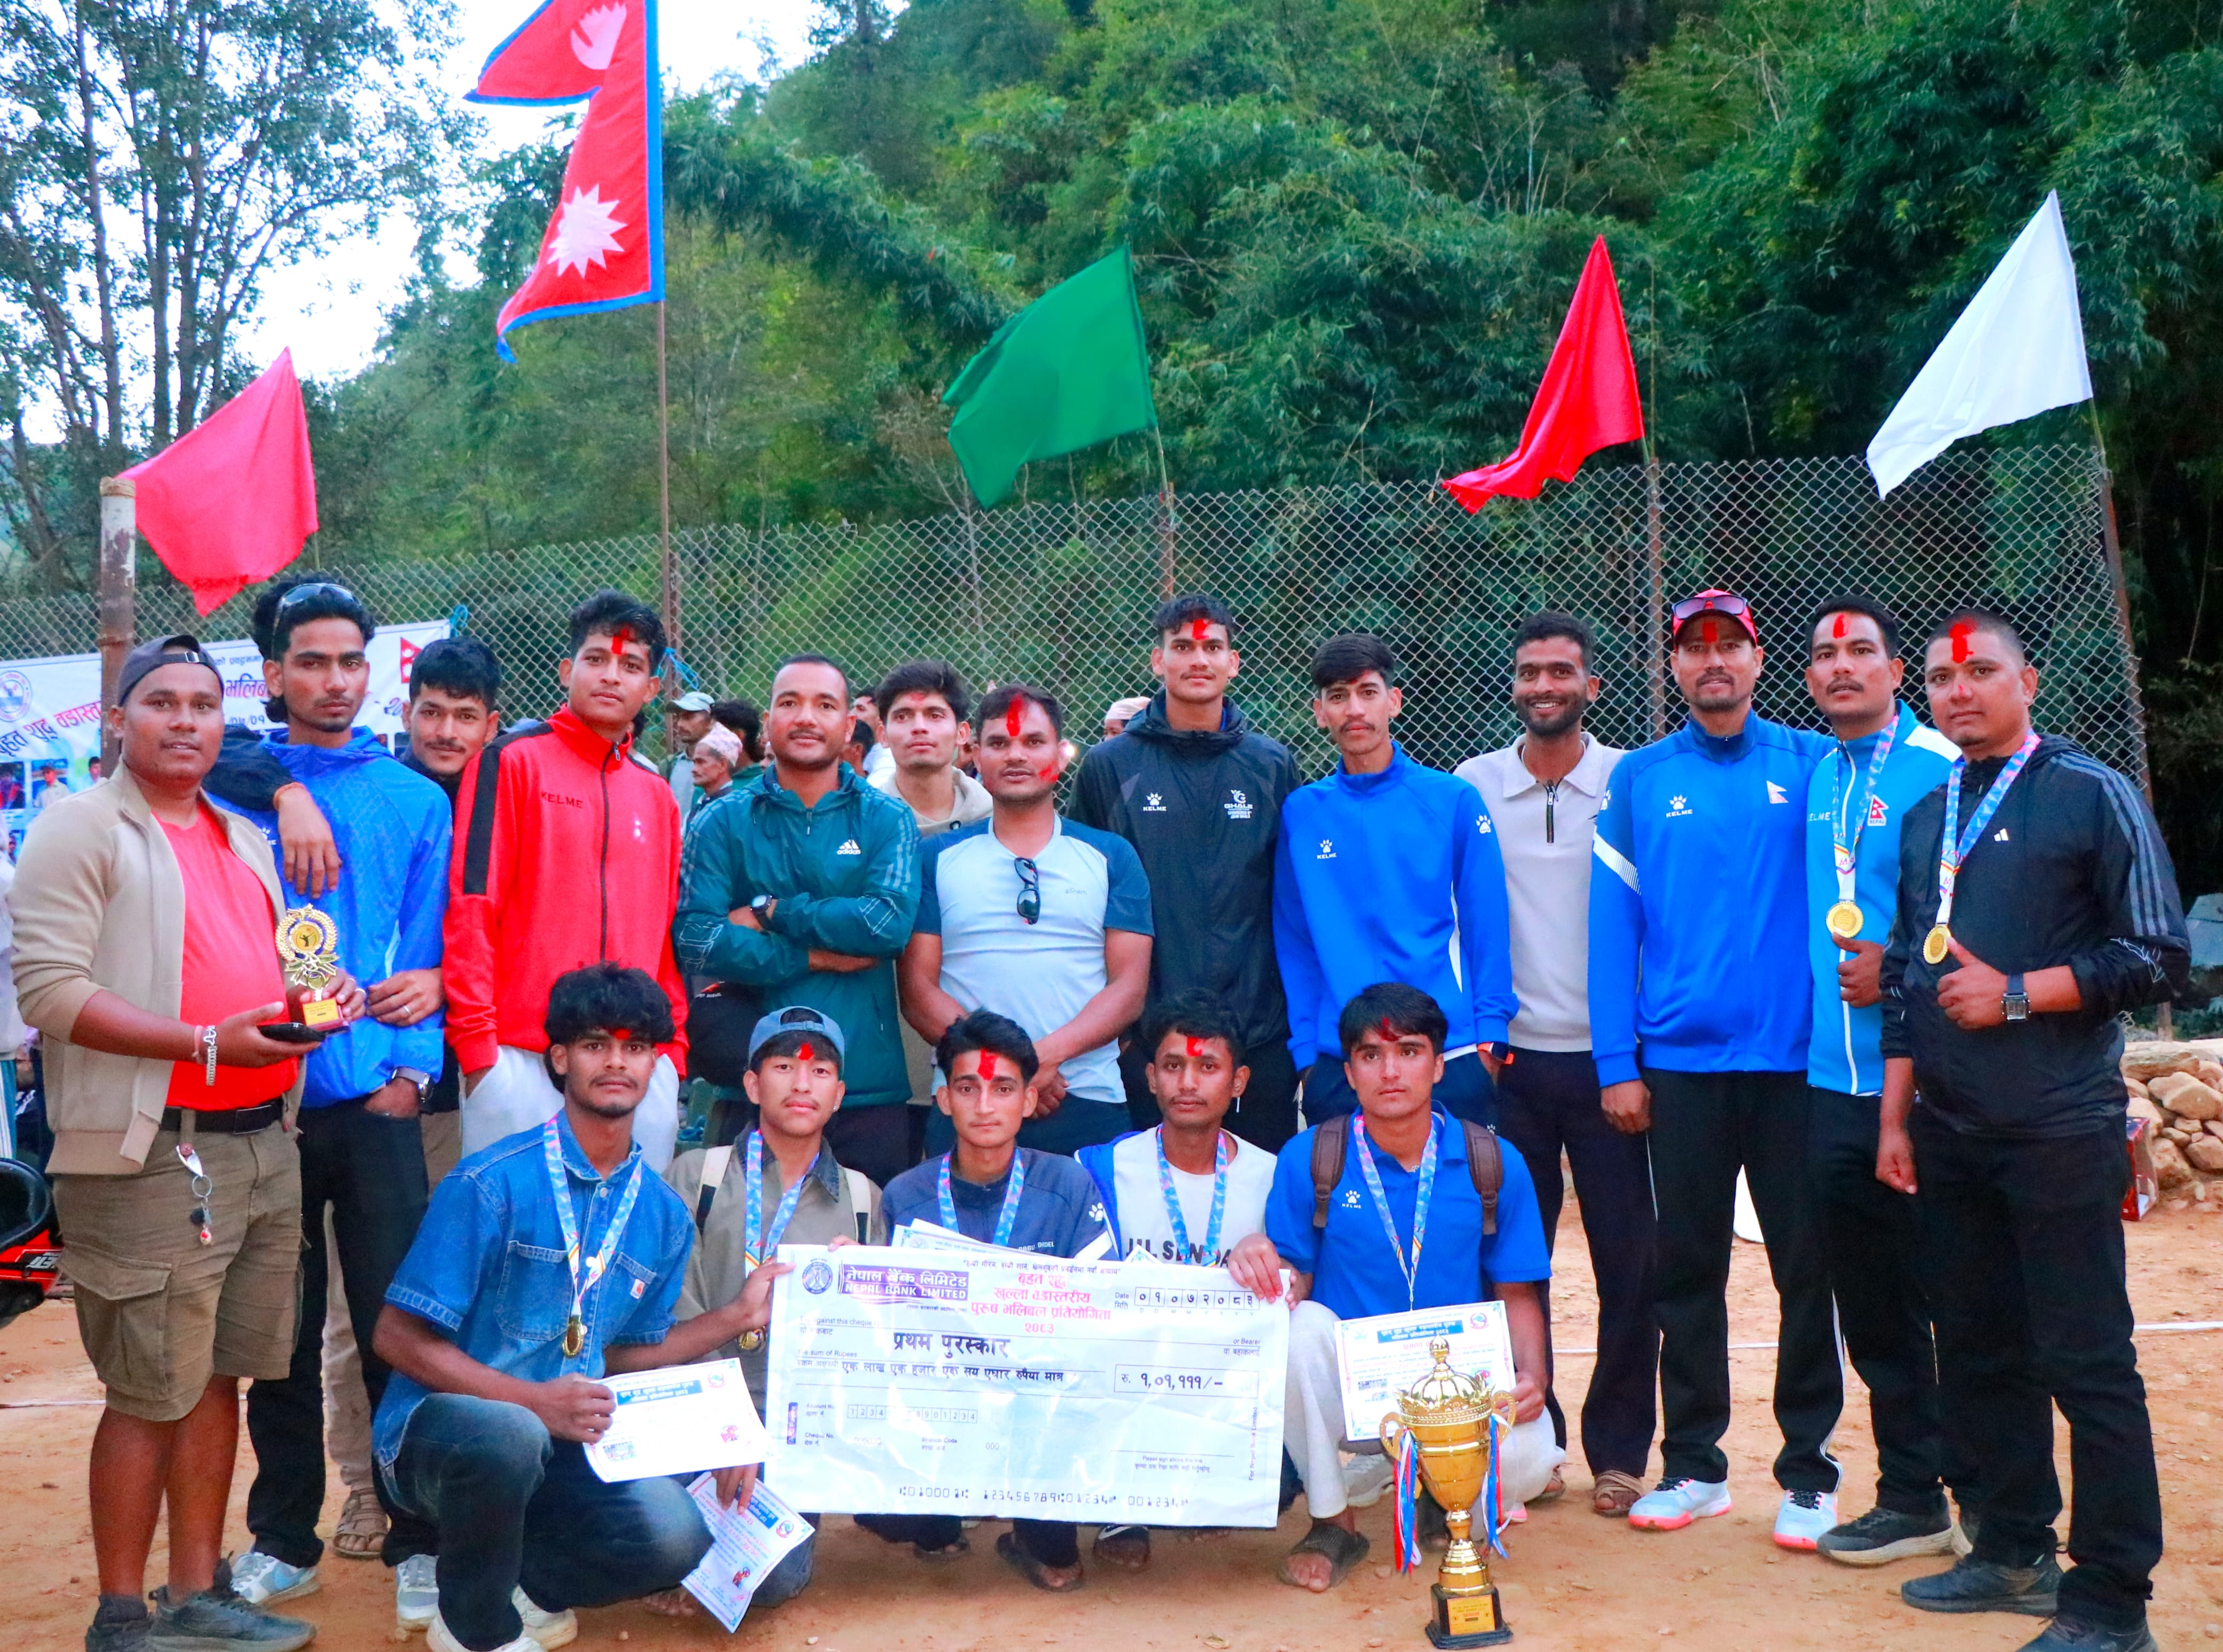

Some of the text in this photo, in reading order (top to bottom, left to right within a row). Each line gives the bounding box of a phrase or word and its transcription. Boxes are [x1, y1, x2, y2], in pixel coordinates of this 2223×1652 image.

[541, 791, 584, 809] KELME
[1666, 809, 1693, 818] KELME
[845, 1267, 881, 1282] नेपाल
[919, 1271, 968, 1287] लिमिटेड
[845, 1283, 966, 1299] NEPAL BANK LIMITED
[994, 1288, 1090, 1304] खुल्ला वडास्तरीय
[971, 1302, 998, 1316] पुरुष
[1002, 1302, 1047, 1317] भलिबल
[1051, 1305, 1111, 1320] प्रतियोगिता
[1115, 1300, 1128, 1309] मिति
[850, 1318, 872, 1327] cheque
[1024, 1322, 1054, 1334] २०८३
[893, 1332, 1011, 1358] प्रथम पुरस्कार
[842, 1361, 859, 1374] एक
[864, 1362, 885, 1373] लाख
[890, 1363, 907, 1376] एक
[912, 1365, 937, 1376] हजार
[943, 1366, 959, 1378] एक
[963, 1367, 980, 1376] सय
[984, 1369, 1011, 1381] एघार
[1044, 1372, 1064, 1382] मात्र
[1141, 1373, 1223, 1390] १,०१,१११/-
[985, 1442, 1000, 1451] 000
